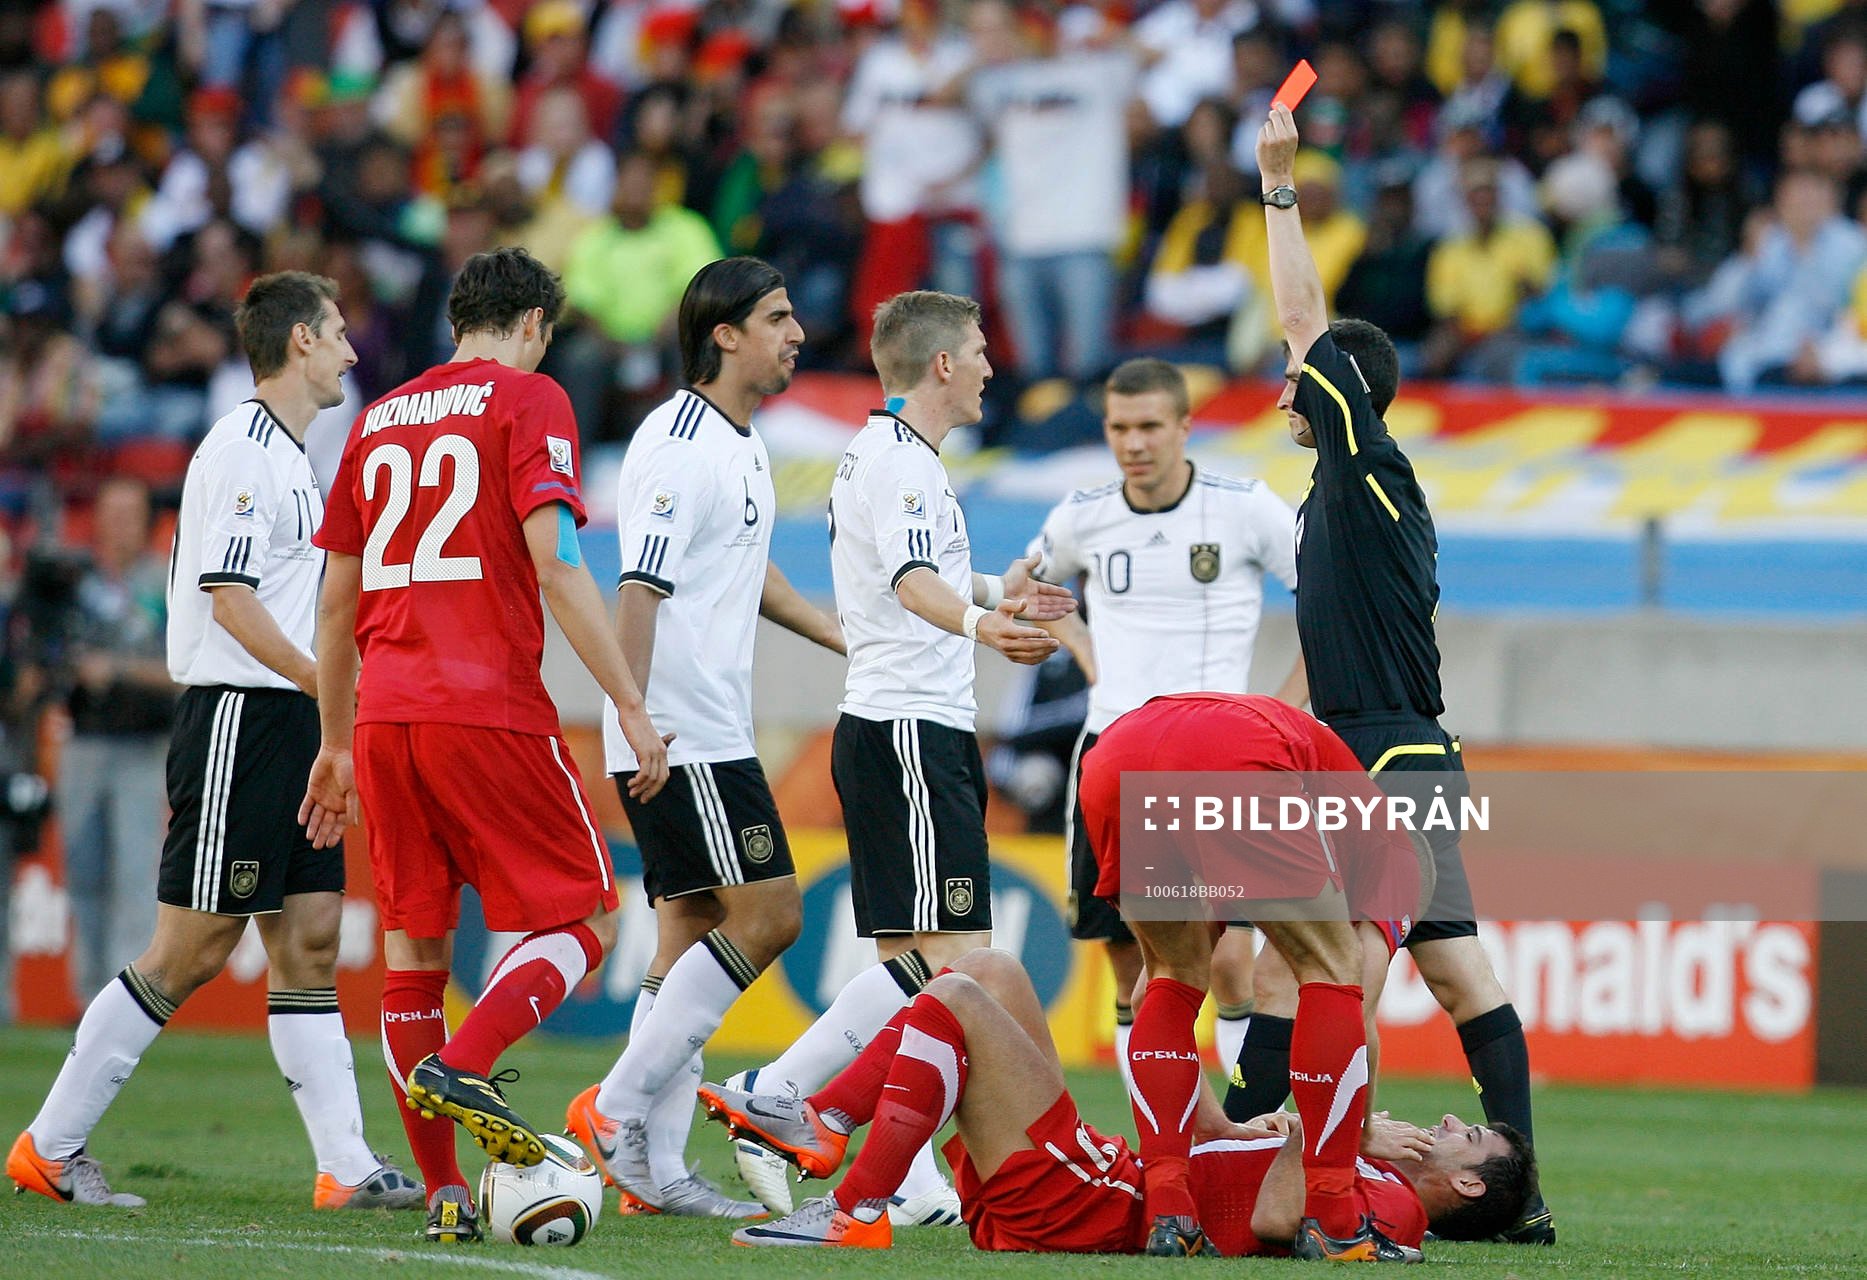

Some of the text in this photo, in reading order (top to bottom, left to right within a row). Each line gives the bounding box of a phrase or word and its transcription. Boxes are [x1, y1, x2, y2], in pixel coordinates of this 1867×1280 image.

[292, 488, 315, 541] 11
[362, 433, 483, 592] 22
[743, 475, 759, 527] 6
[1093, 550, 1131, 594] 10
[1288, 1068, 1333, 1083] РБИЈА
